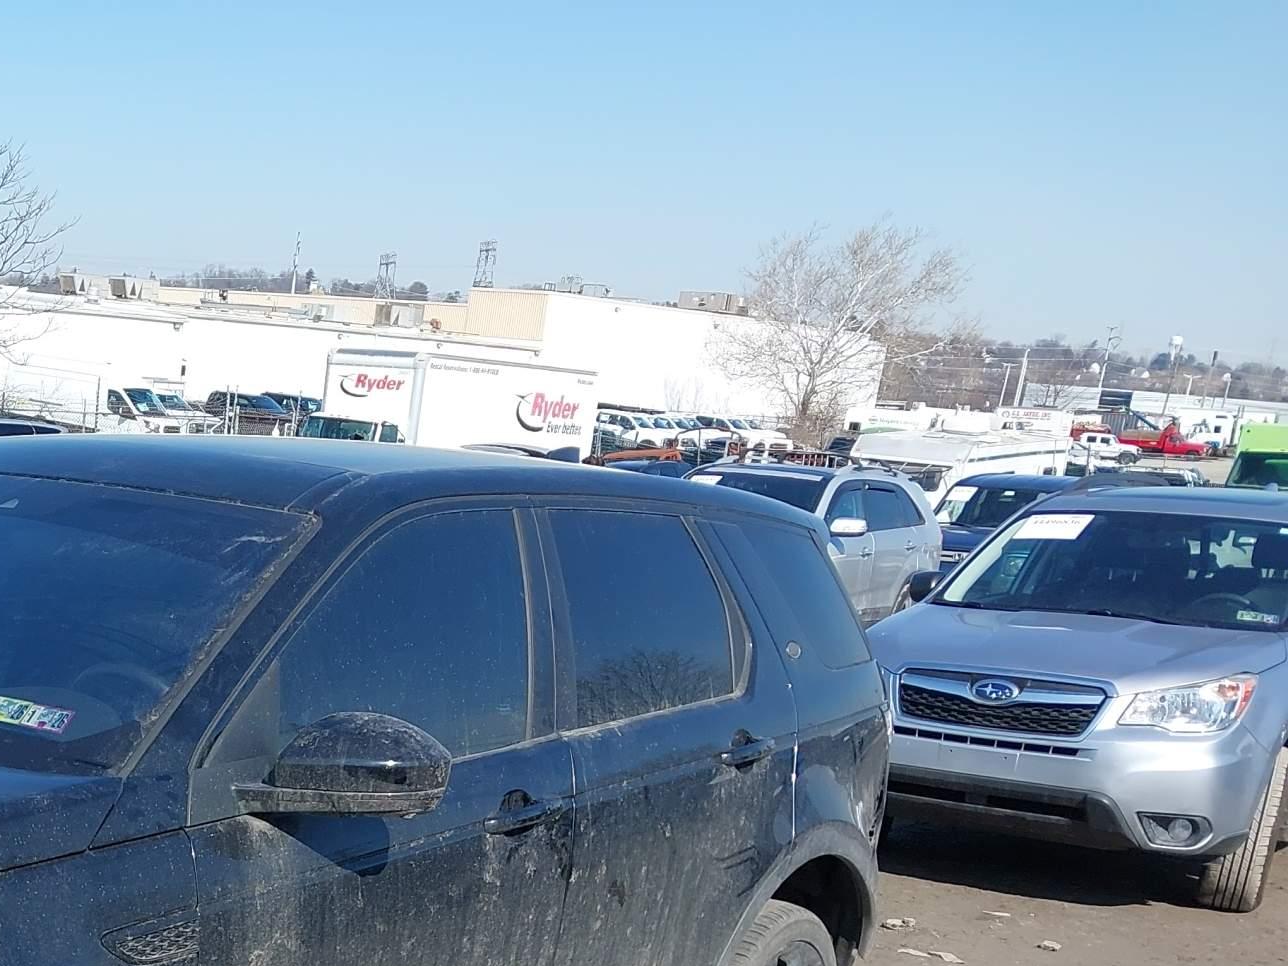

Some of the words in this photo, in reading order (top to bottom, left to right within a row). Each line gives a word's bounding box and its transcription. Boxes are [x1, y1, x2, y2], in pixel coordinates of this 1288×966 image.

[354, 373, 405, 392] Ryder
[531, 391, 580, 423] Ryder
[546, 421, 562, 434] Ever
